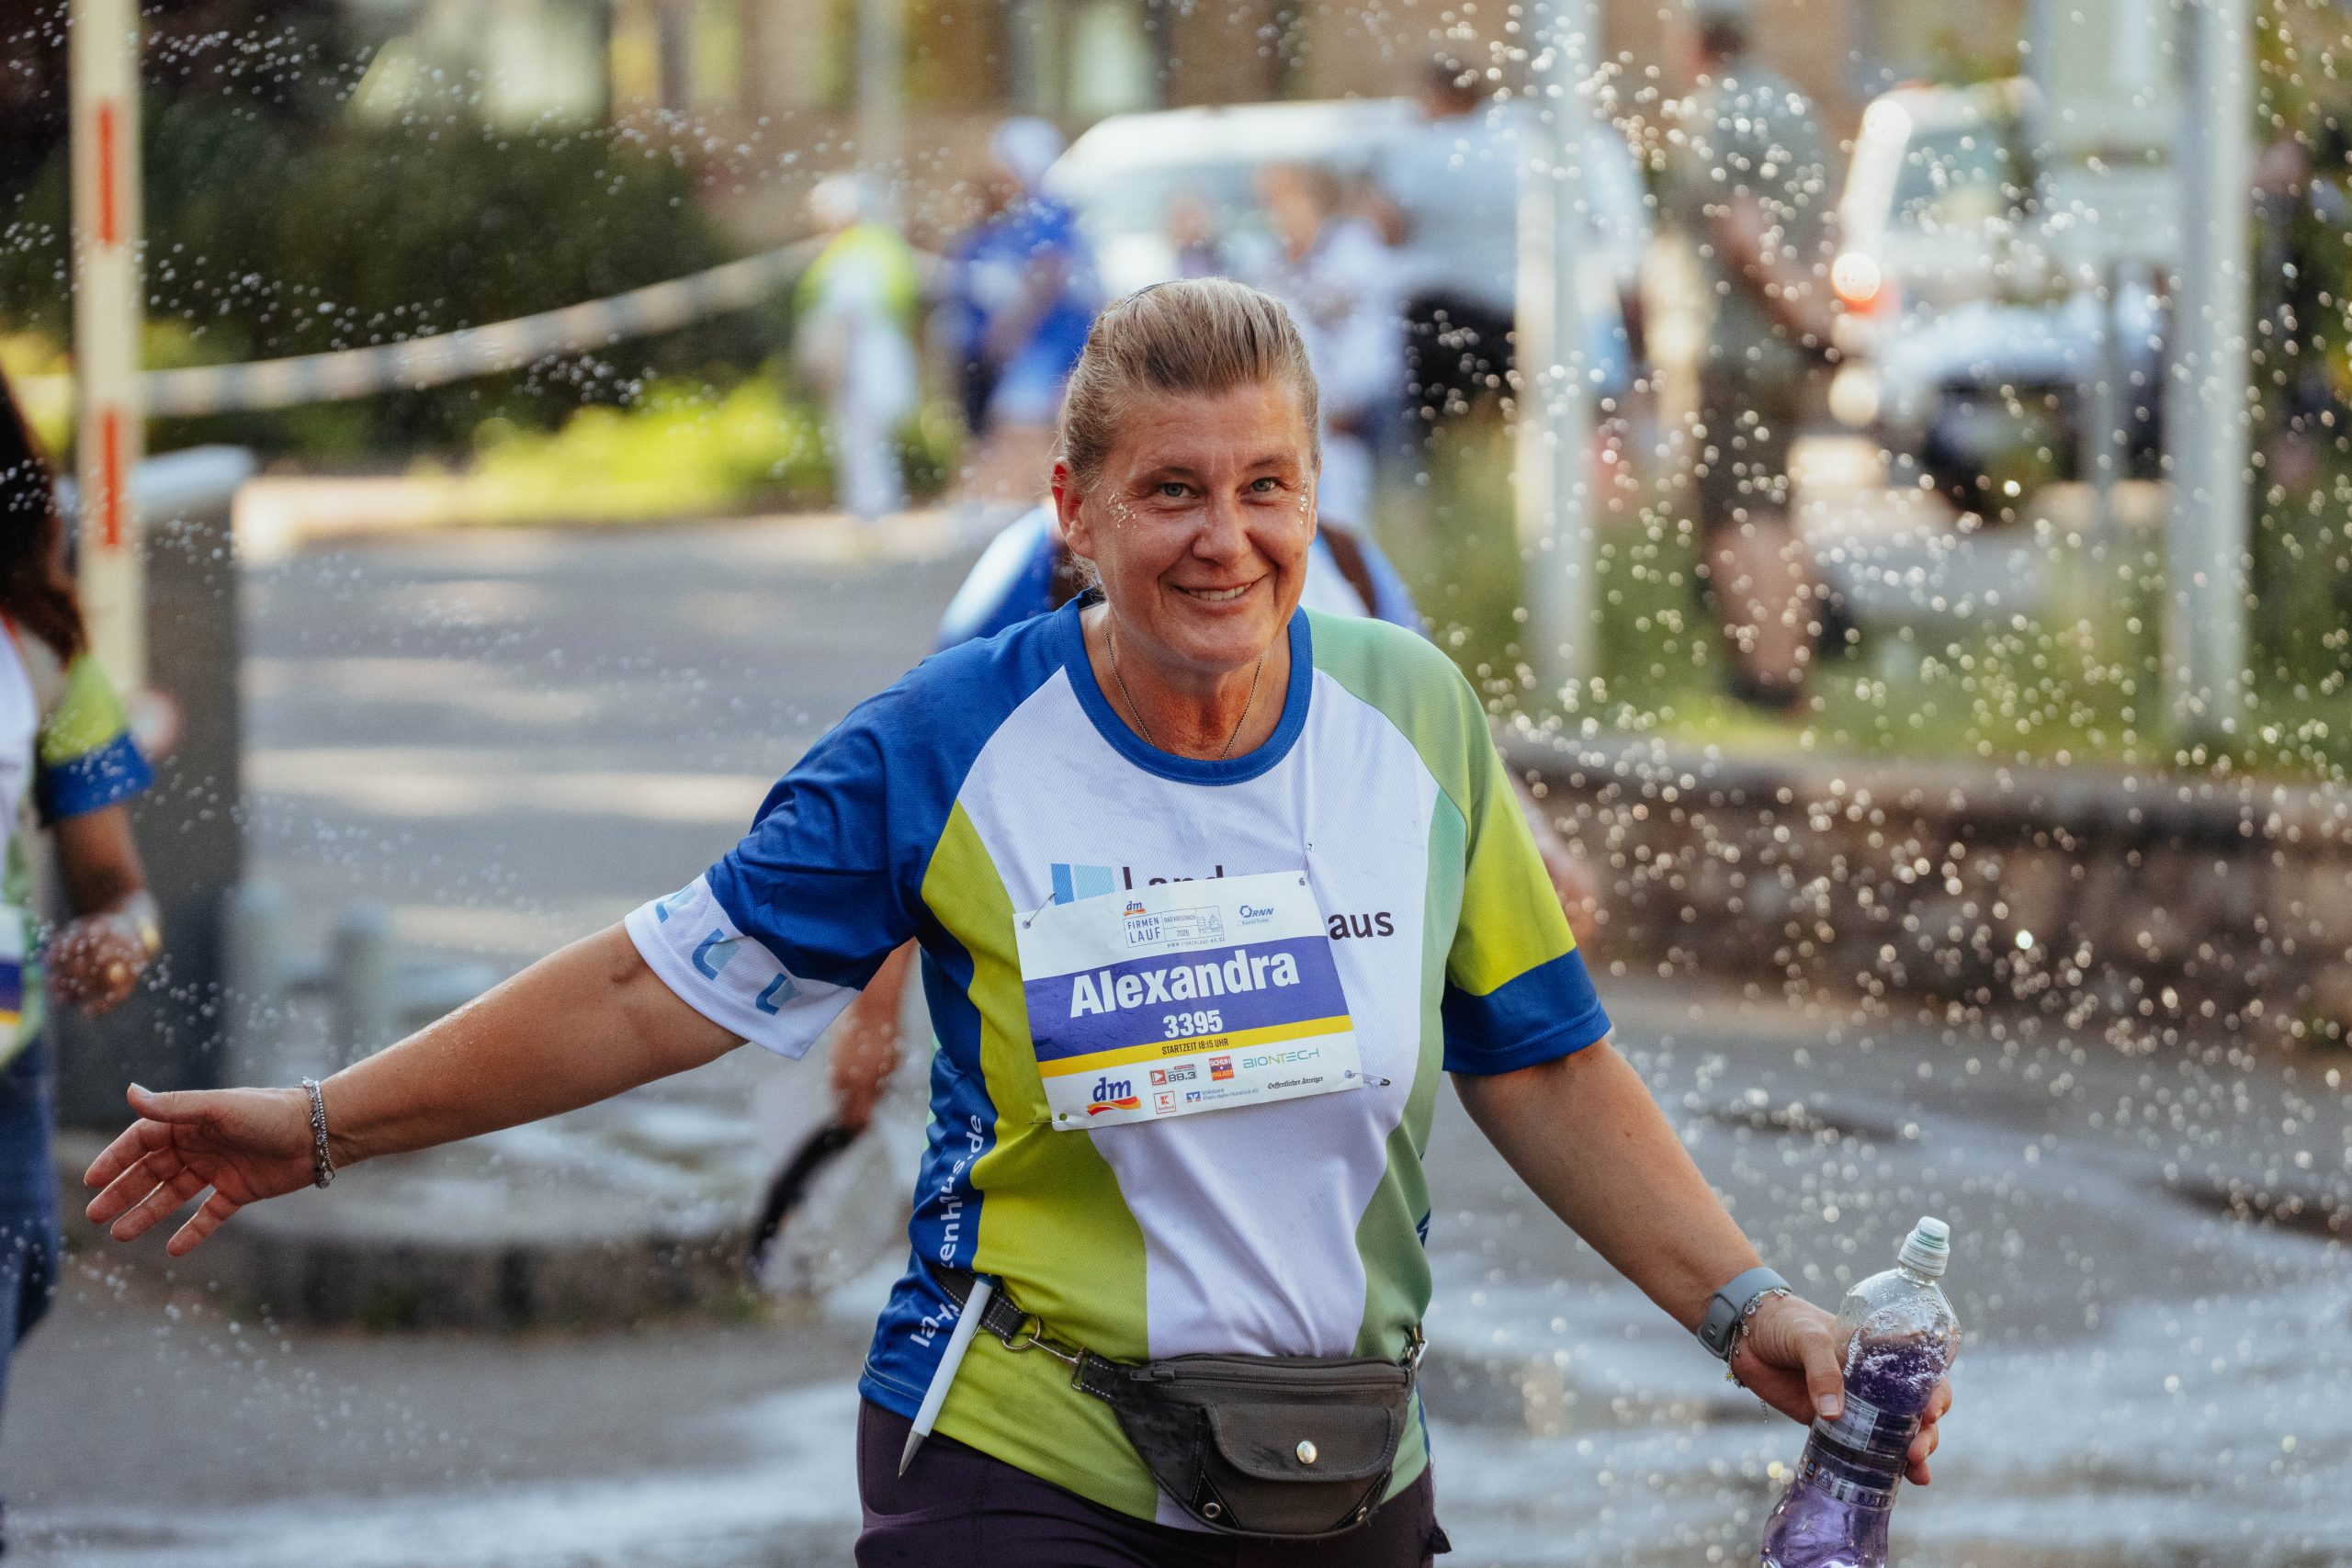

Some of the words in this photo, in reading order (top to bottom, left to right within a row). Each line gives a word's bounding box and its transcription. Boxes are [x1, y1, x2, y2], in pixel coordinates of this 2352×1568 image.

[1125, 900, 1143, 911] dm
[1127, 917, 1159, 930] FIRMEN
[1129, 927, 1160, 943] LAUF
[1069, 949, 1301, 1019] Alexandra
[1162, 1010, 1224, 1038] 3395
[1161, 1042, 1197, 1055] STARTZEIT
[1198, 1040, 1214, 1050] 18:15
[1215, 1038, 1229, 1048] UHR
[1209, 1058, 1231, 1066] SCHUH
[1242, 1048, 1320, 1068] BIONTECH
[1168, 1071, 1196, 1082] 88.3
[1092, 1077, 1131, 1102] dm
